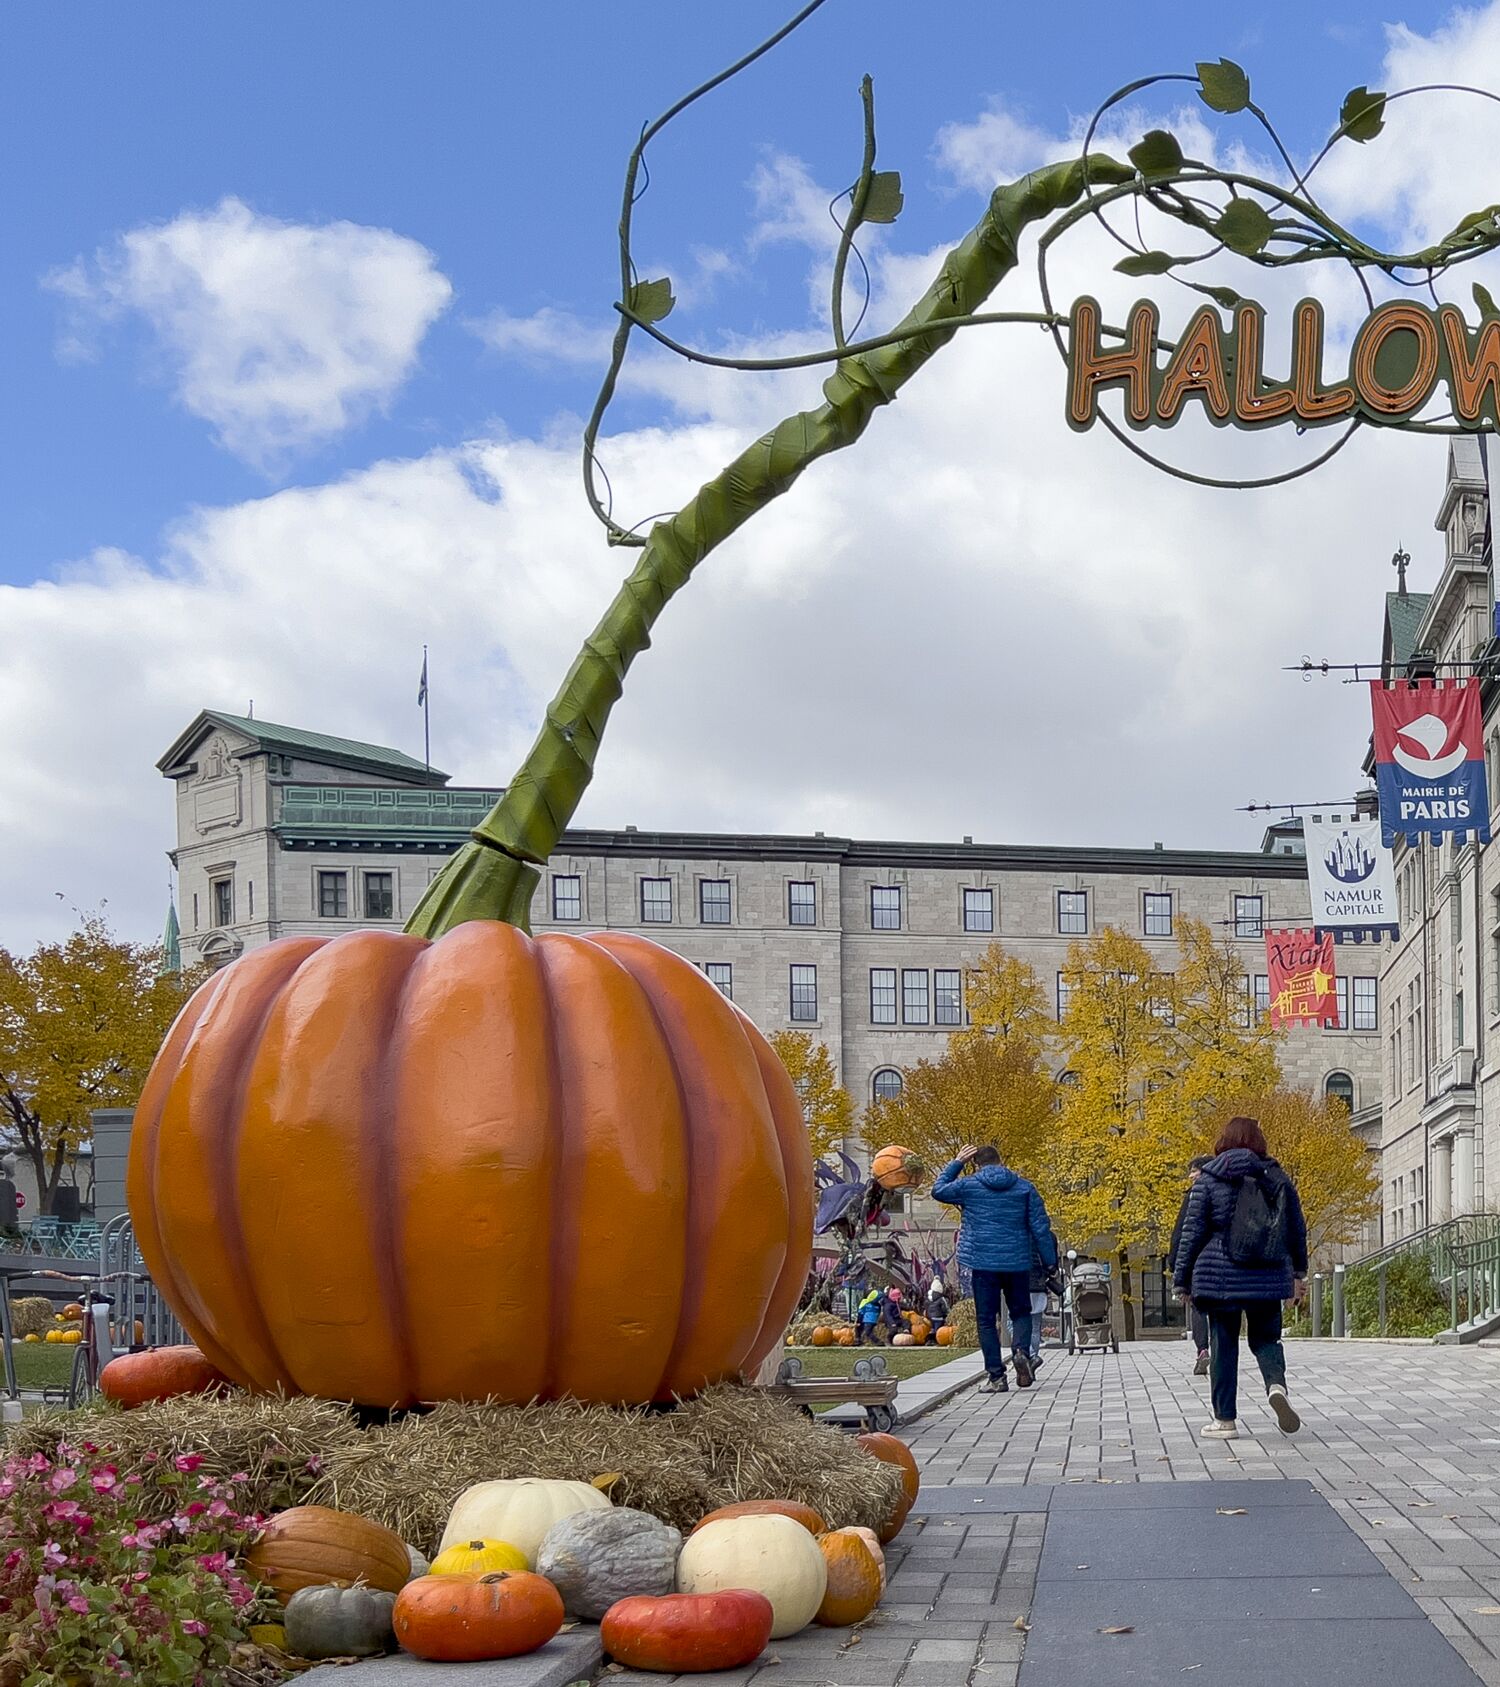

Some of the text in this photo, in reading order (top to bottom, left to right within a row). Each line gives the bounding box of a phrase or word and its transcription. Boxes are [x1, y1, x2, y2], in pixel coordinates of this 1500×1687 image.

[1402, 786, 1465, 797] MAIRIE DE
[1401, 800, 1470, 820] PARIS
[1324, 889, 1382, 902] NAMUR
[1326, 904, 1384, 916] CAPITALE
